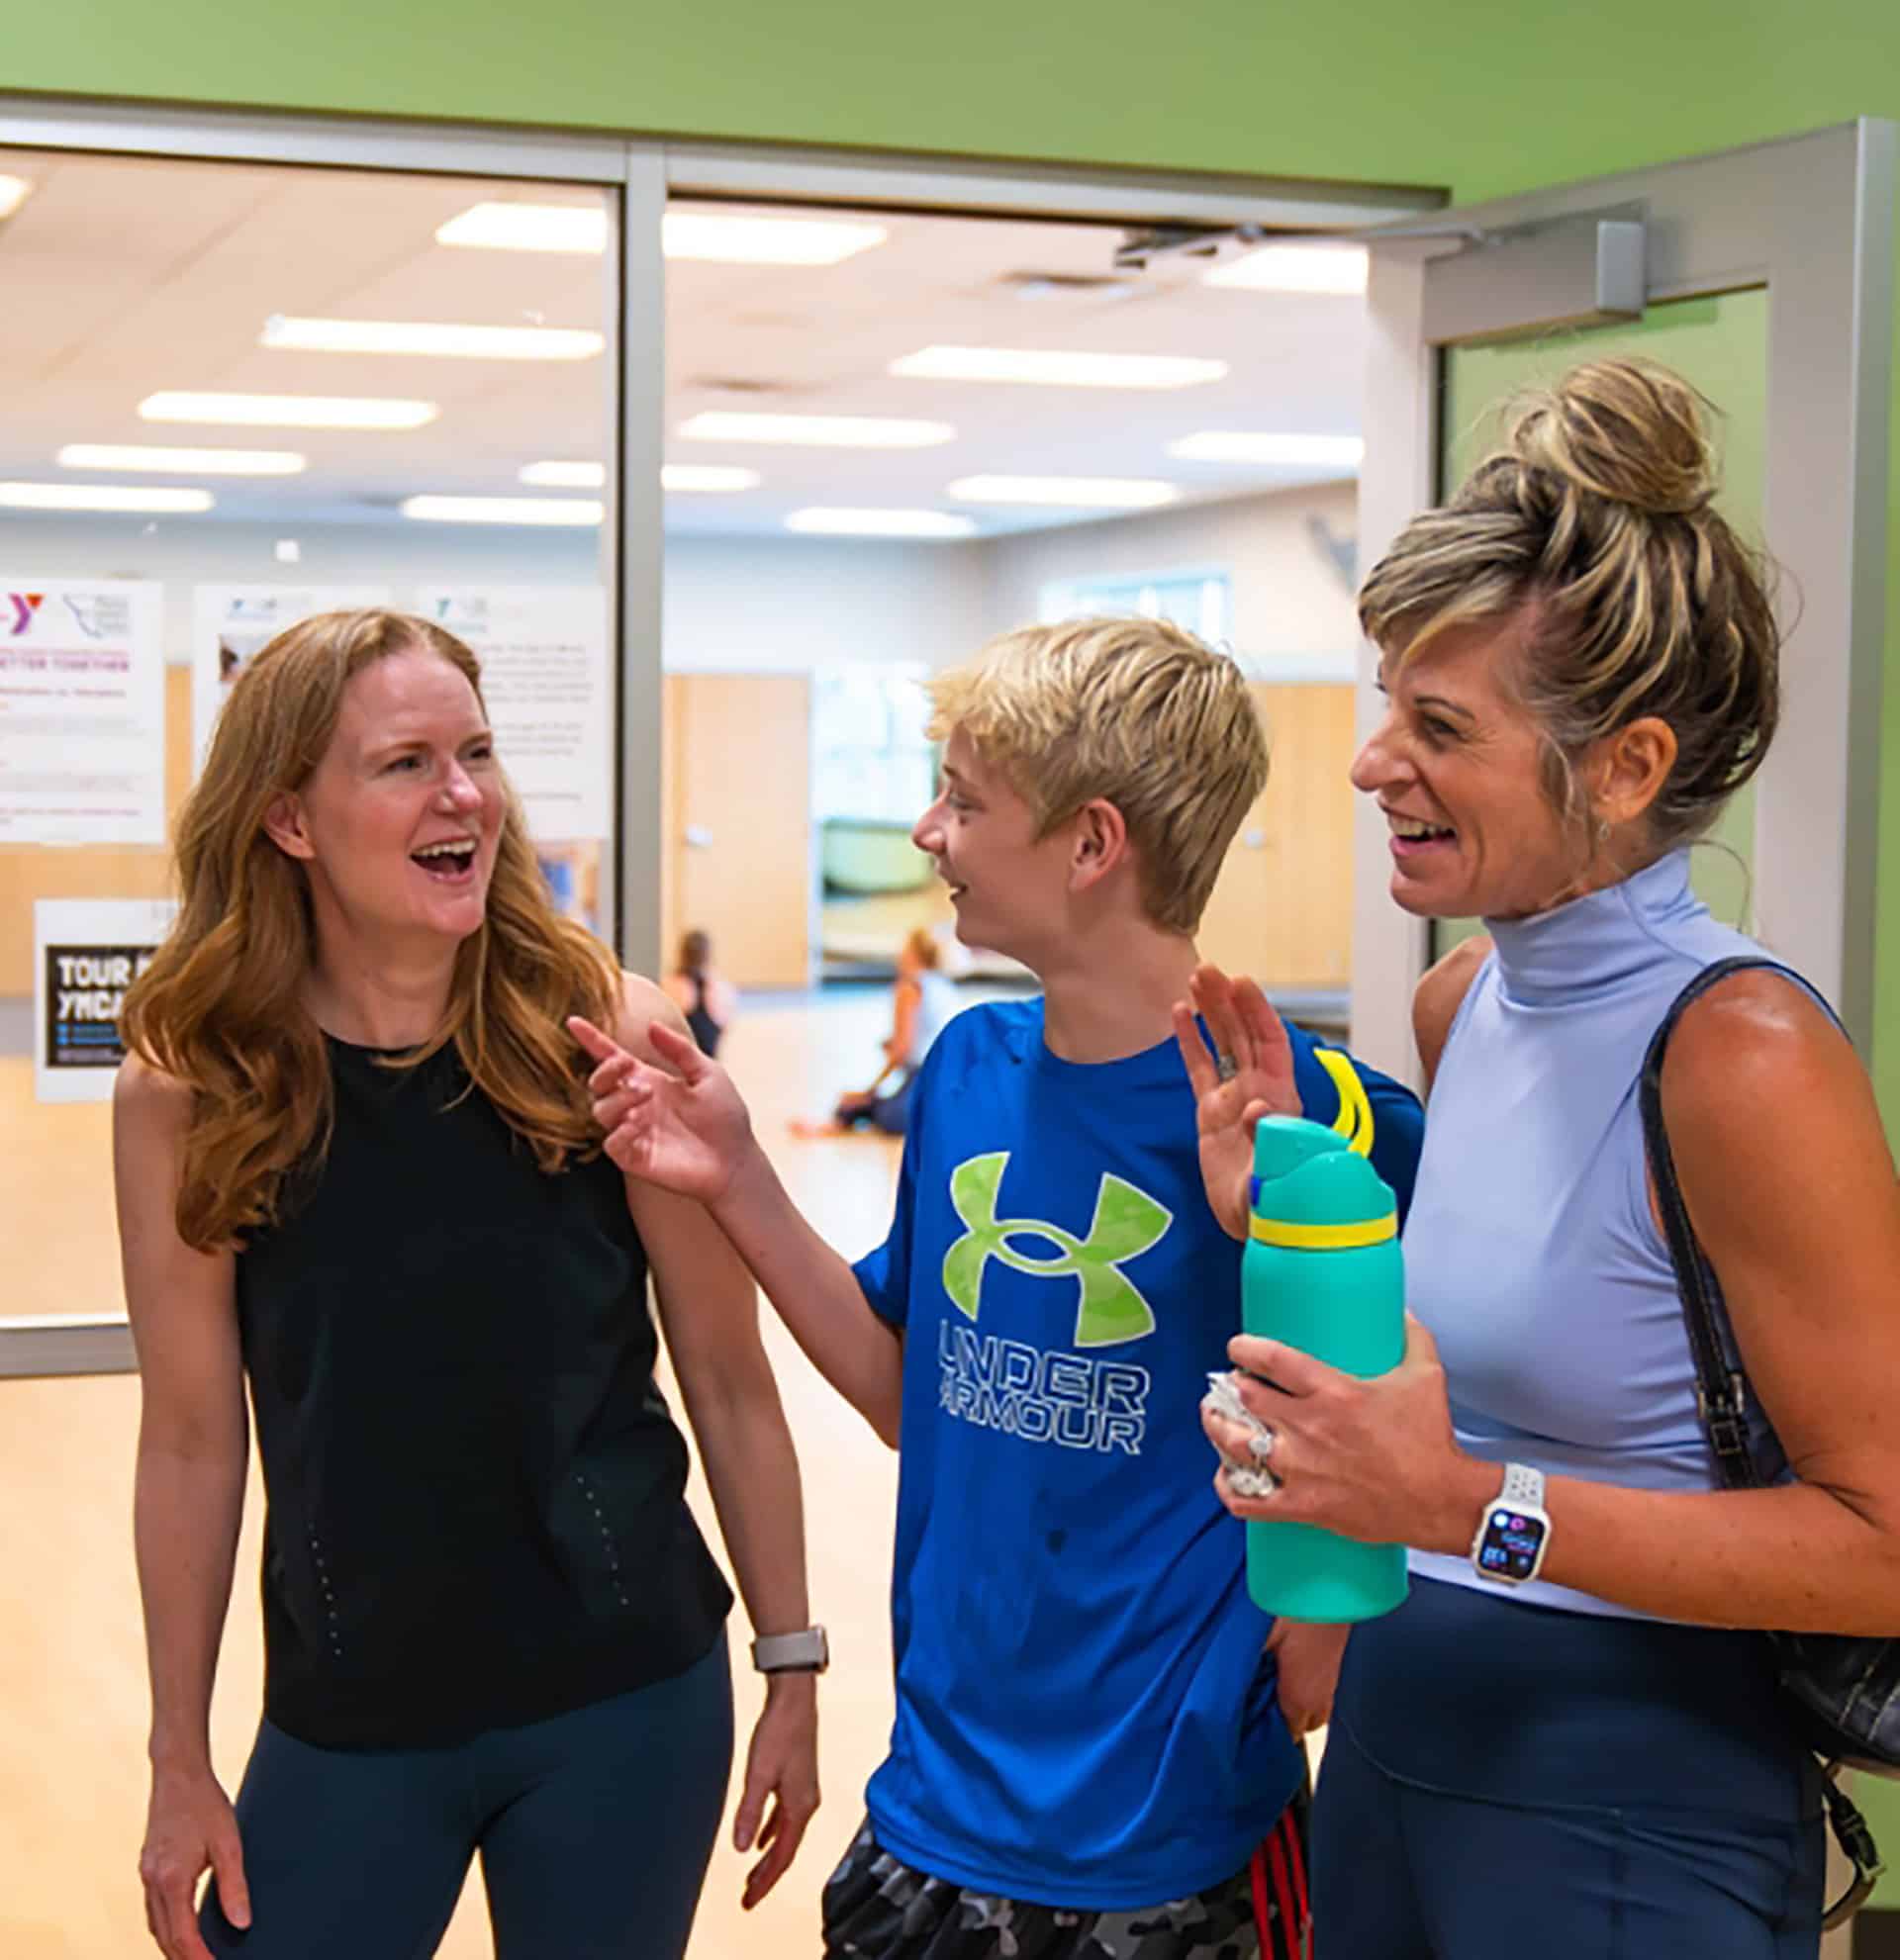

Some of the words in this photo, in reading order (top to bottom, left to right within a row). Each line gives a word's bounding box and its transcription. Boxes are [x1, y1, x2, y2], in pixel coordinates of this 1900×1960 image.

[57, 956, 131, 986] TOUR
[939, 1317, 1152, 1416] UNDER
[939, 1369, 1147, 1456] ARMOUR
